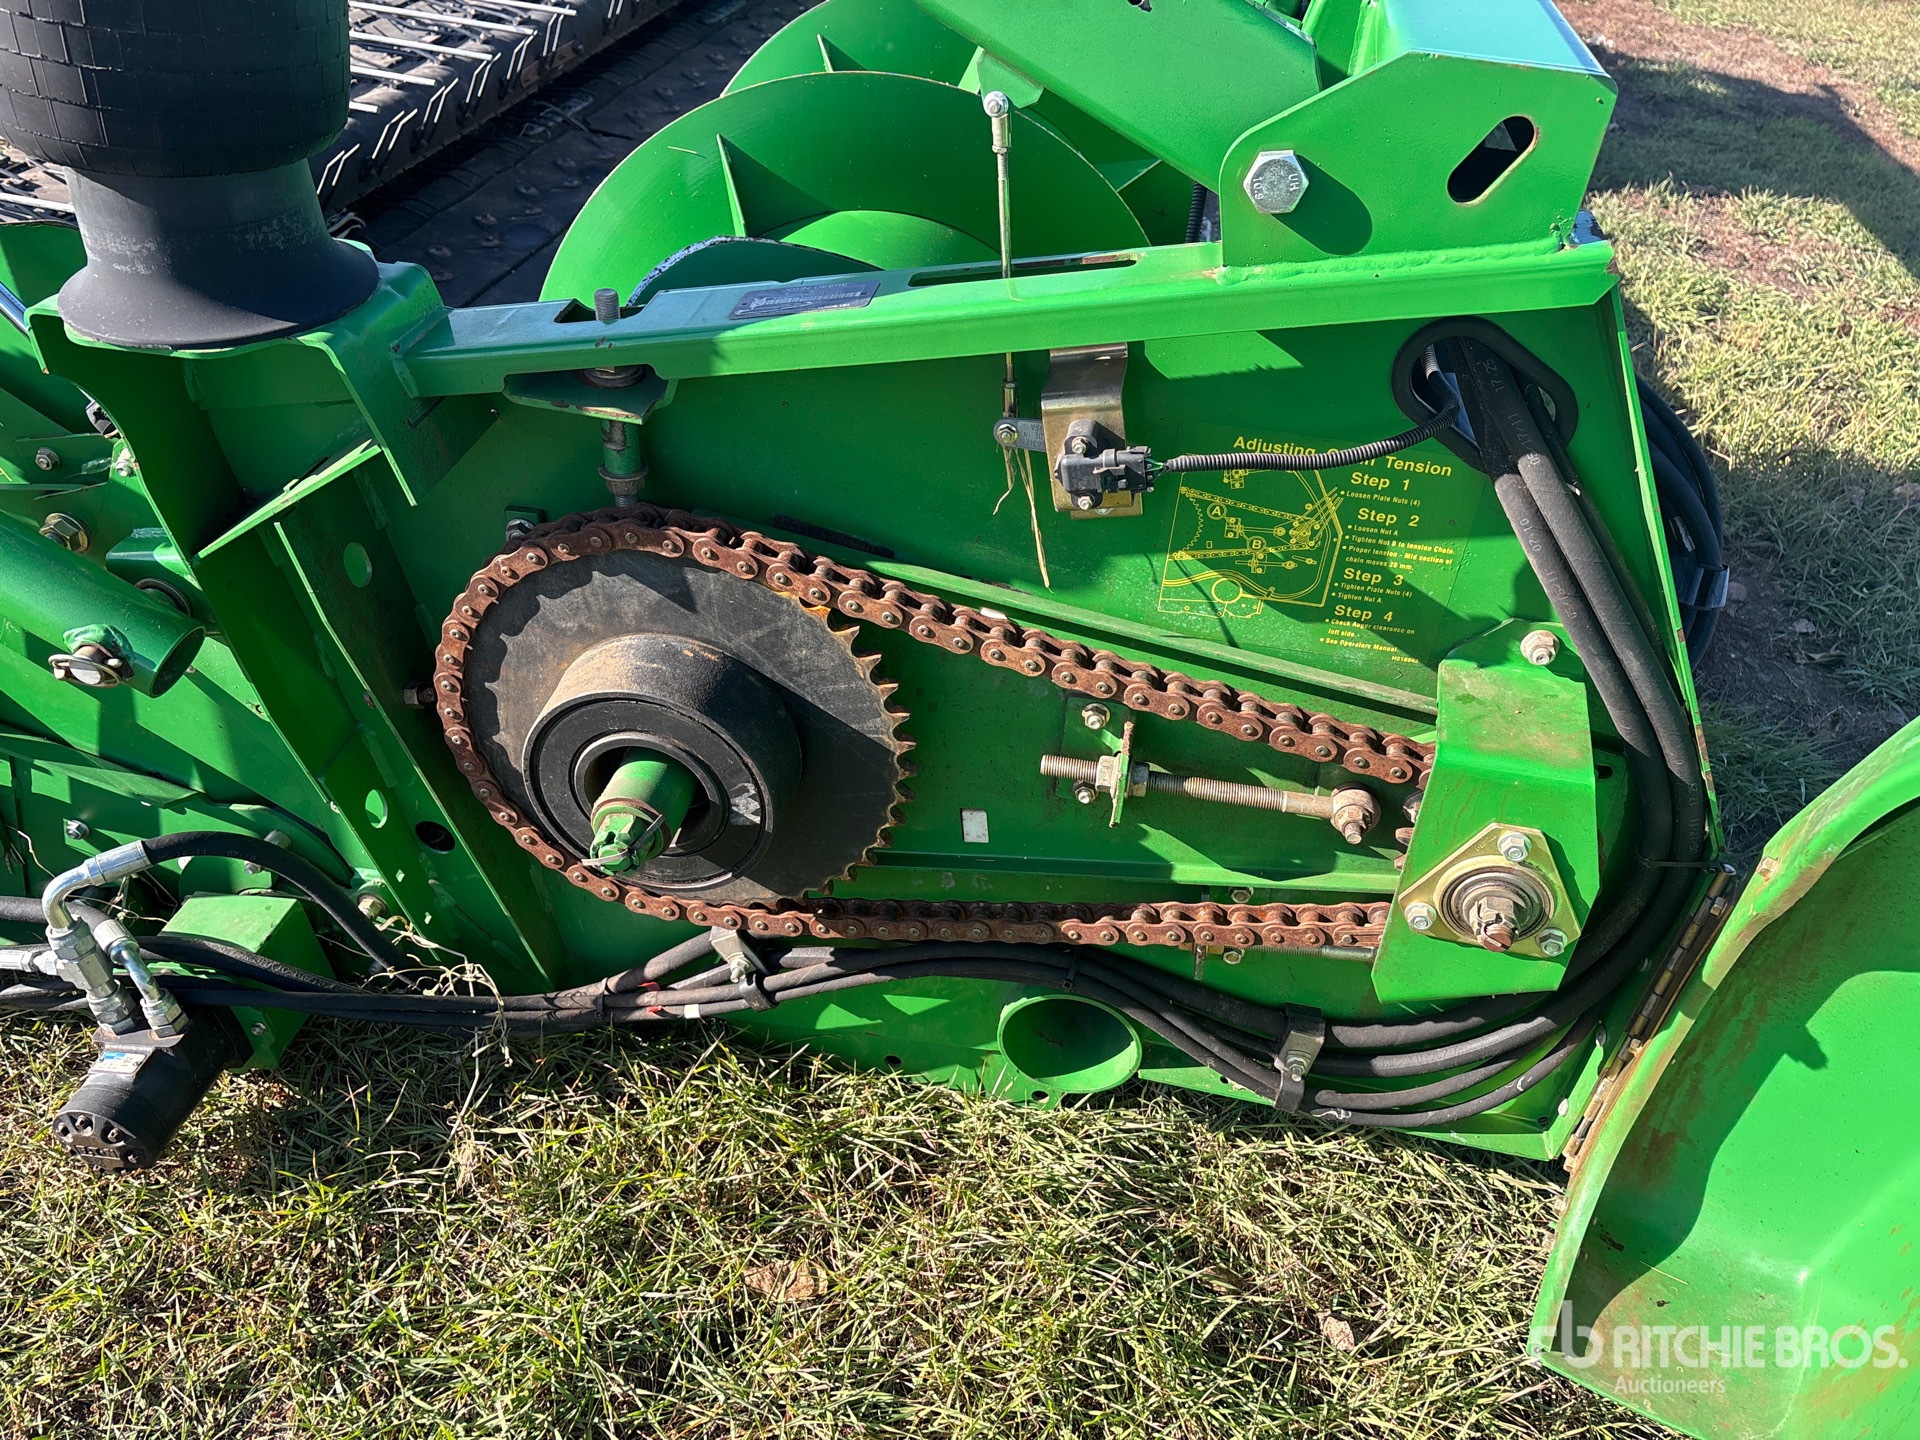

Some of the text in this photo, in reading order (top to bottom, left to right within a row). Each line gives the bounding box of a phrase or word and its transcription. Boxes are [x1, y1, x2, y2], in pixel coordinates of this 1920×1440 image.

[1233, 436, 1316, 456] Adjusting
[1385, 455, 1453, 477] Tension
[1350, 471, 1410, 491] Step 1
[1346, 490, 1421, 508] Loosen Plate Nuts (4)
[1211, 505, 1222, 517] A
[1357, 507, 1420, 527] Step 2
[1353, 524, 1379, 534] Loosen
[1380, 528, 1392, 536] Nut
[1251, 540, 1262, 550] B
[1351, 535, 1377, 545] Tighten
[1378, 538, 1390, 546] Nut
[1406, 542, 1432, 552] tension
[1345, 556, 1364, 564] chain
[1365, 559, 1387, 567] moves
[1348, 545, 1371, 555] Proper
[1372, 548, 1398, 557] tension
[1418, 555, 1444, 564] section
[1343, 567, 1404, 586] Step 3
[1337, 592, 1362, 602] Tighten
[1340, 582, 1413, 598] Tighten Plate Nuts (4)
[1334, 604, 1394, 622] Step 4
